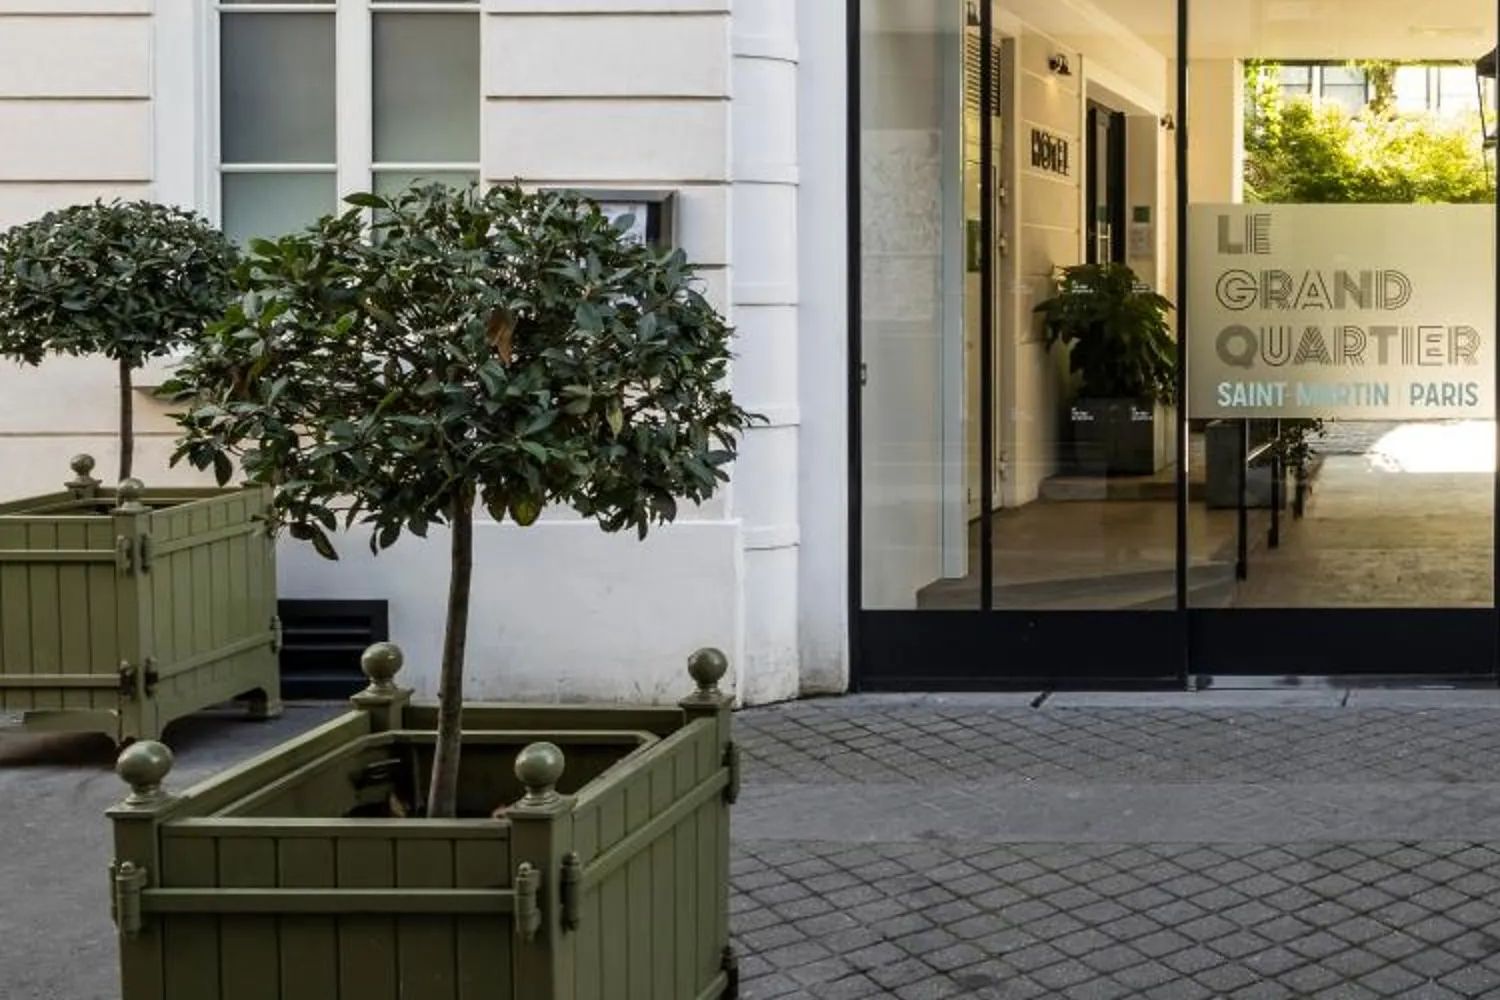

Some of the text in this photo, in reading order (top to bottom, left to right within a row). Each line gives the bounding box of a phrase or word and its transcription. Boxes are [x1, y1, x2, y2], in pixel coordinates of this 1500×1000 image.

[1217, 213, 1271, 255] LE
[1215, 269, 1413, 311] GRAND
[1215, 324, 1481, 370] QUARTIER
[1217, 382, 1479, 407] SAINT MRTIN PARIS
